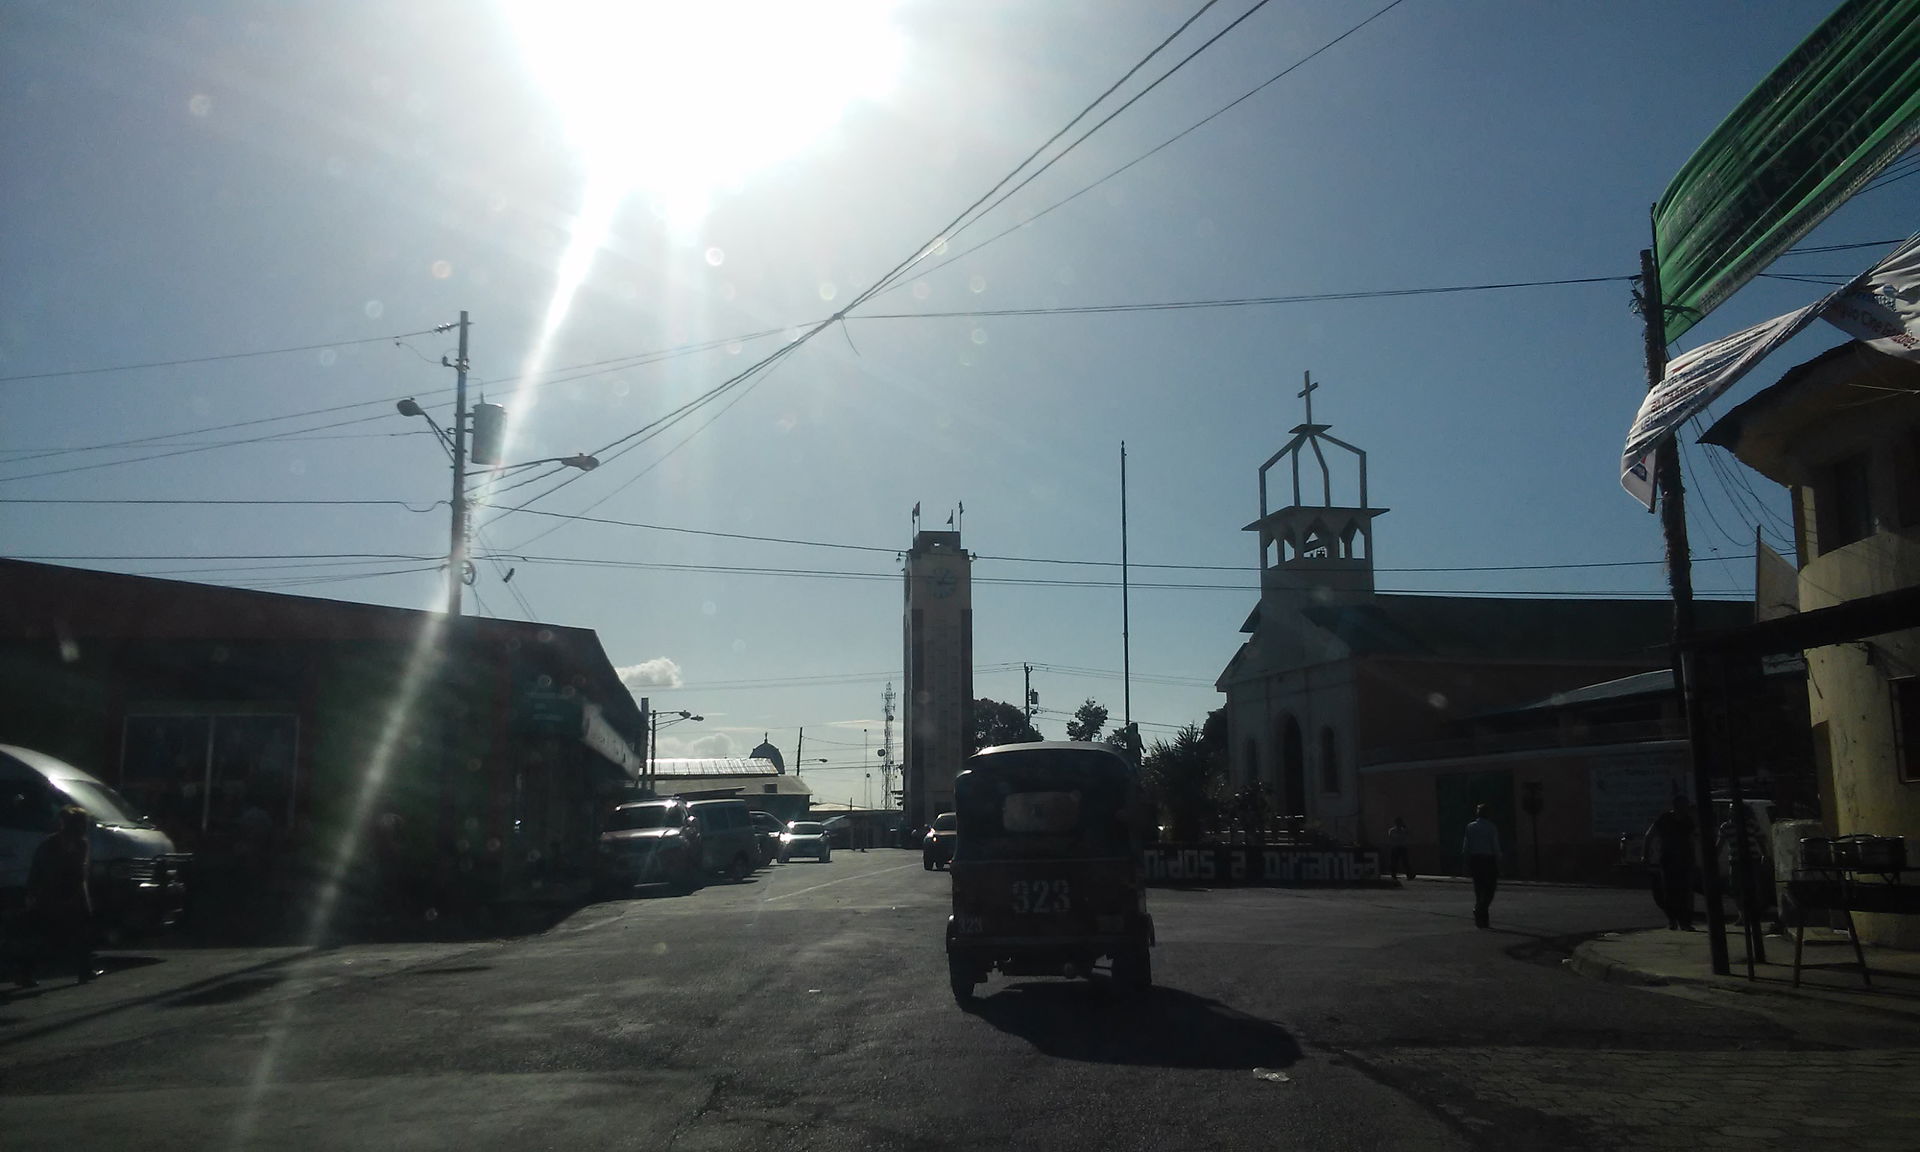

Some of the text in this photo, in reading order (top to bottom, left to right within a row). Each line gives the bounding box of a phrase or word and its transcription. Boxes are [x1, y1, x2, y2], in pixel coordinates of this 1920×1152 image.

[1231, 852, 1246, 879] a
[1263, 851, 1379, 880] Diriamba
[1012, 879, 1071, 913] 323
[958, 916, 983, 934] 323
